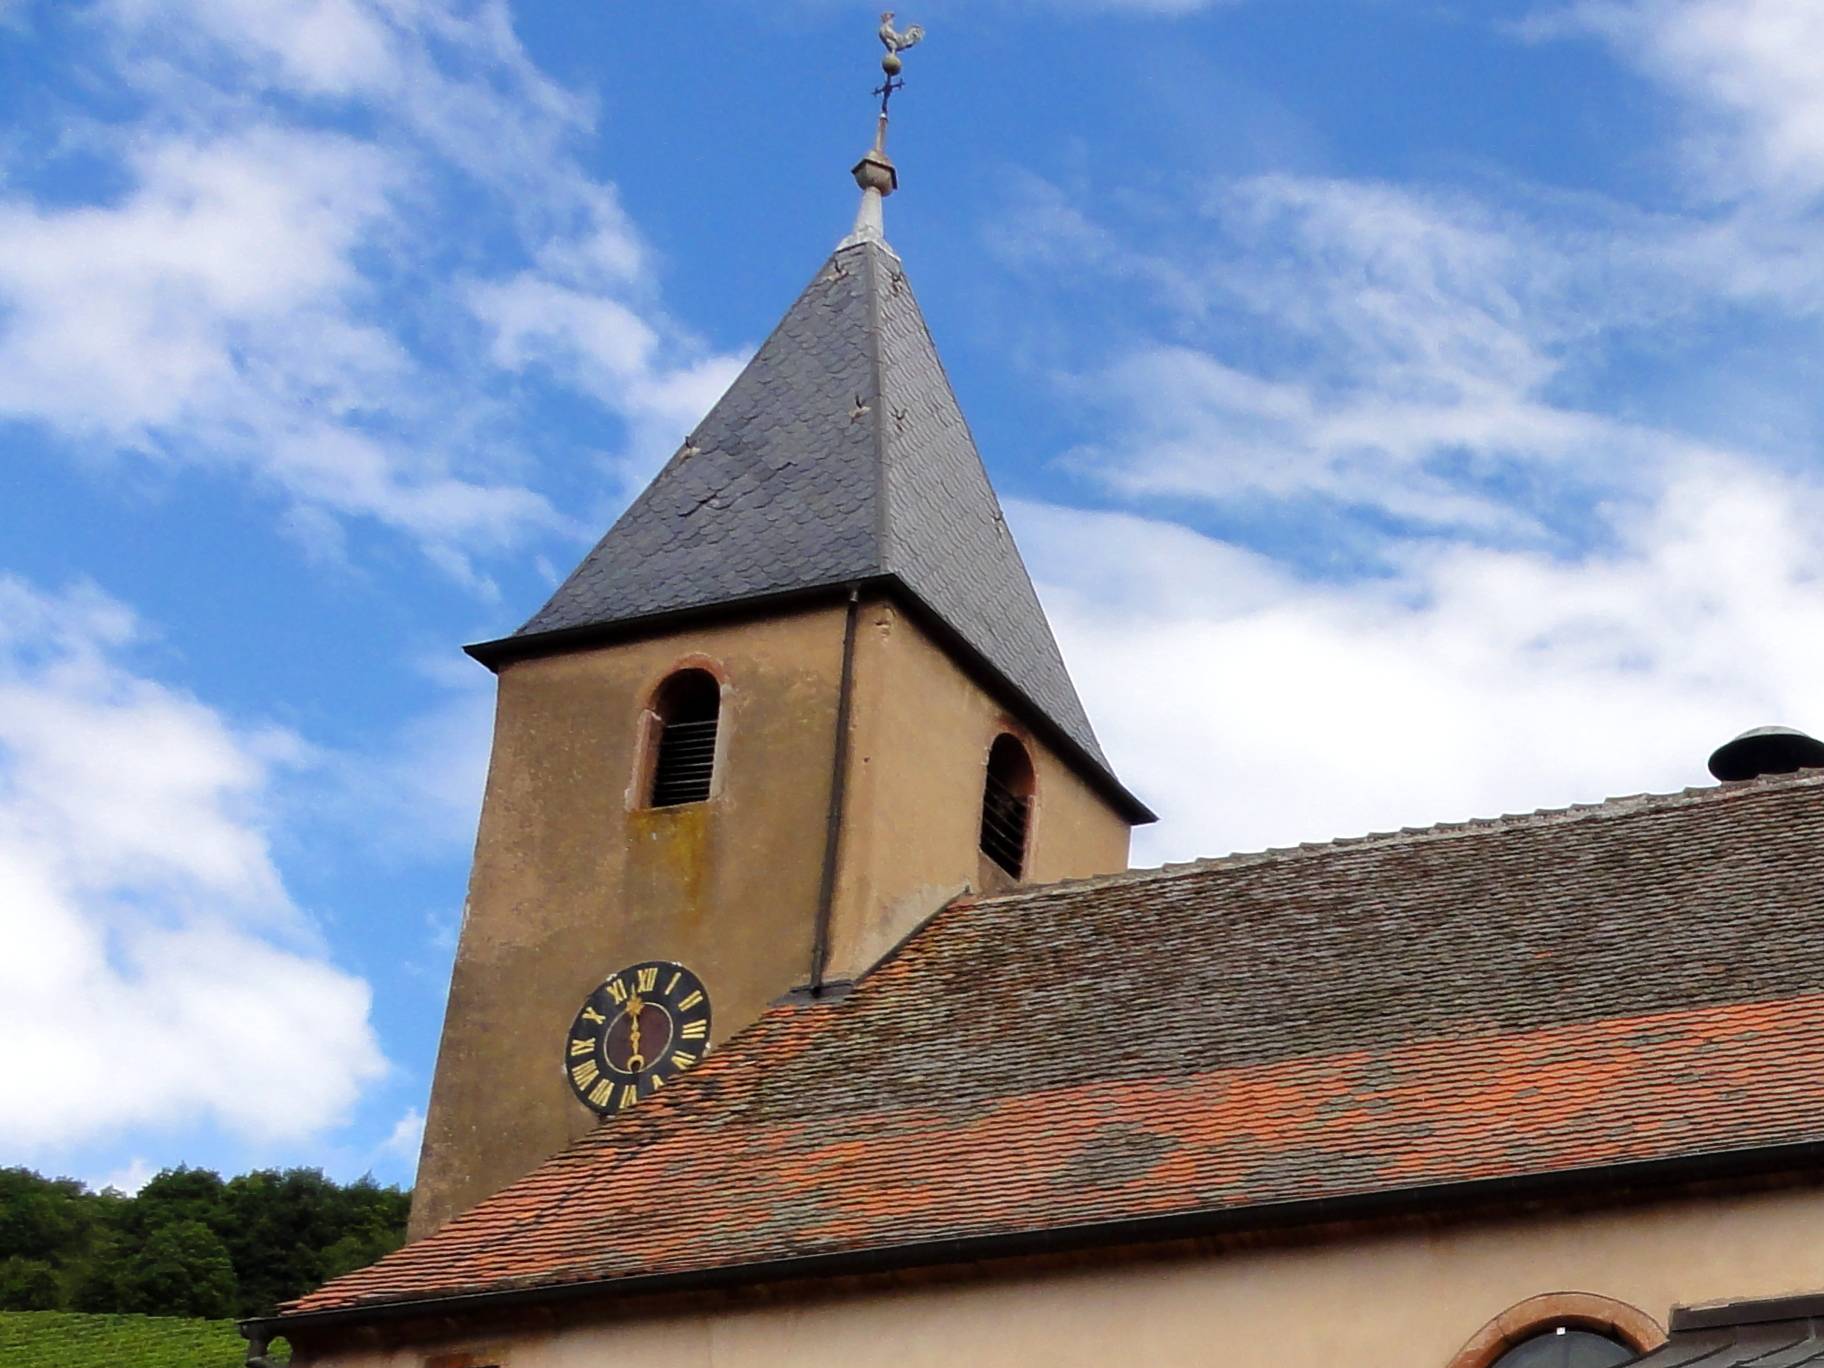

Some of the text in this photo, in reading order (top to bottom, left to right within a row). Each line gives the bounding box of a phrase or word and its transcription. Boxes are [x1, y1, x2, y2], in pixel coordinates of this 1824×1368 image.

[606, 978, 628, 1005] XI
[637, 968, 658, 993] XII
[664, 972, 682, 995] I
[678, 990, 704, 1012] II
[582, 1006, 607, 1025] X
[681, 1019, 707, 1039] III
[571, 1037, 596, 1057] IX
[571, 1059, 600, 1092] VIII
[588, 1078, 616, 1107] VII
